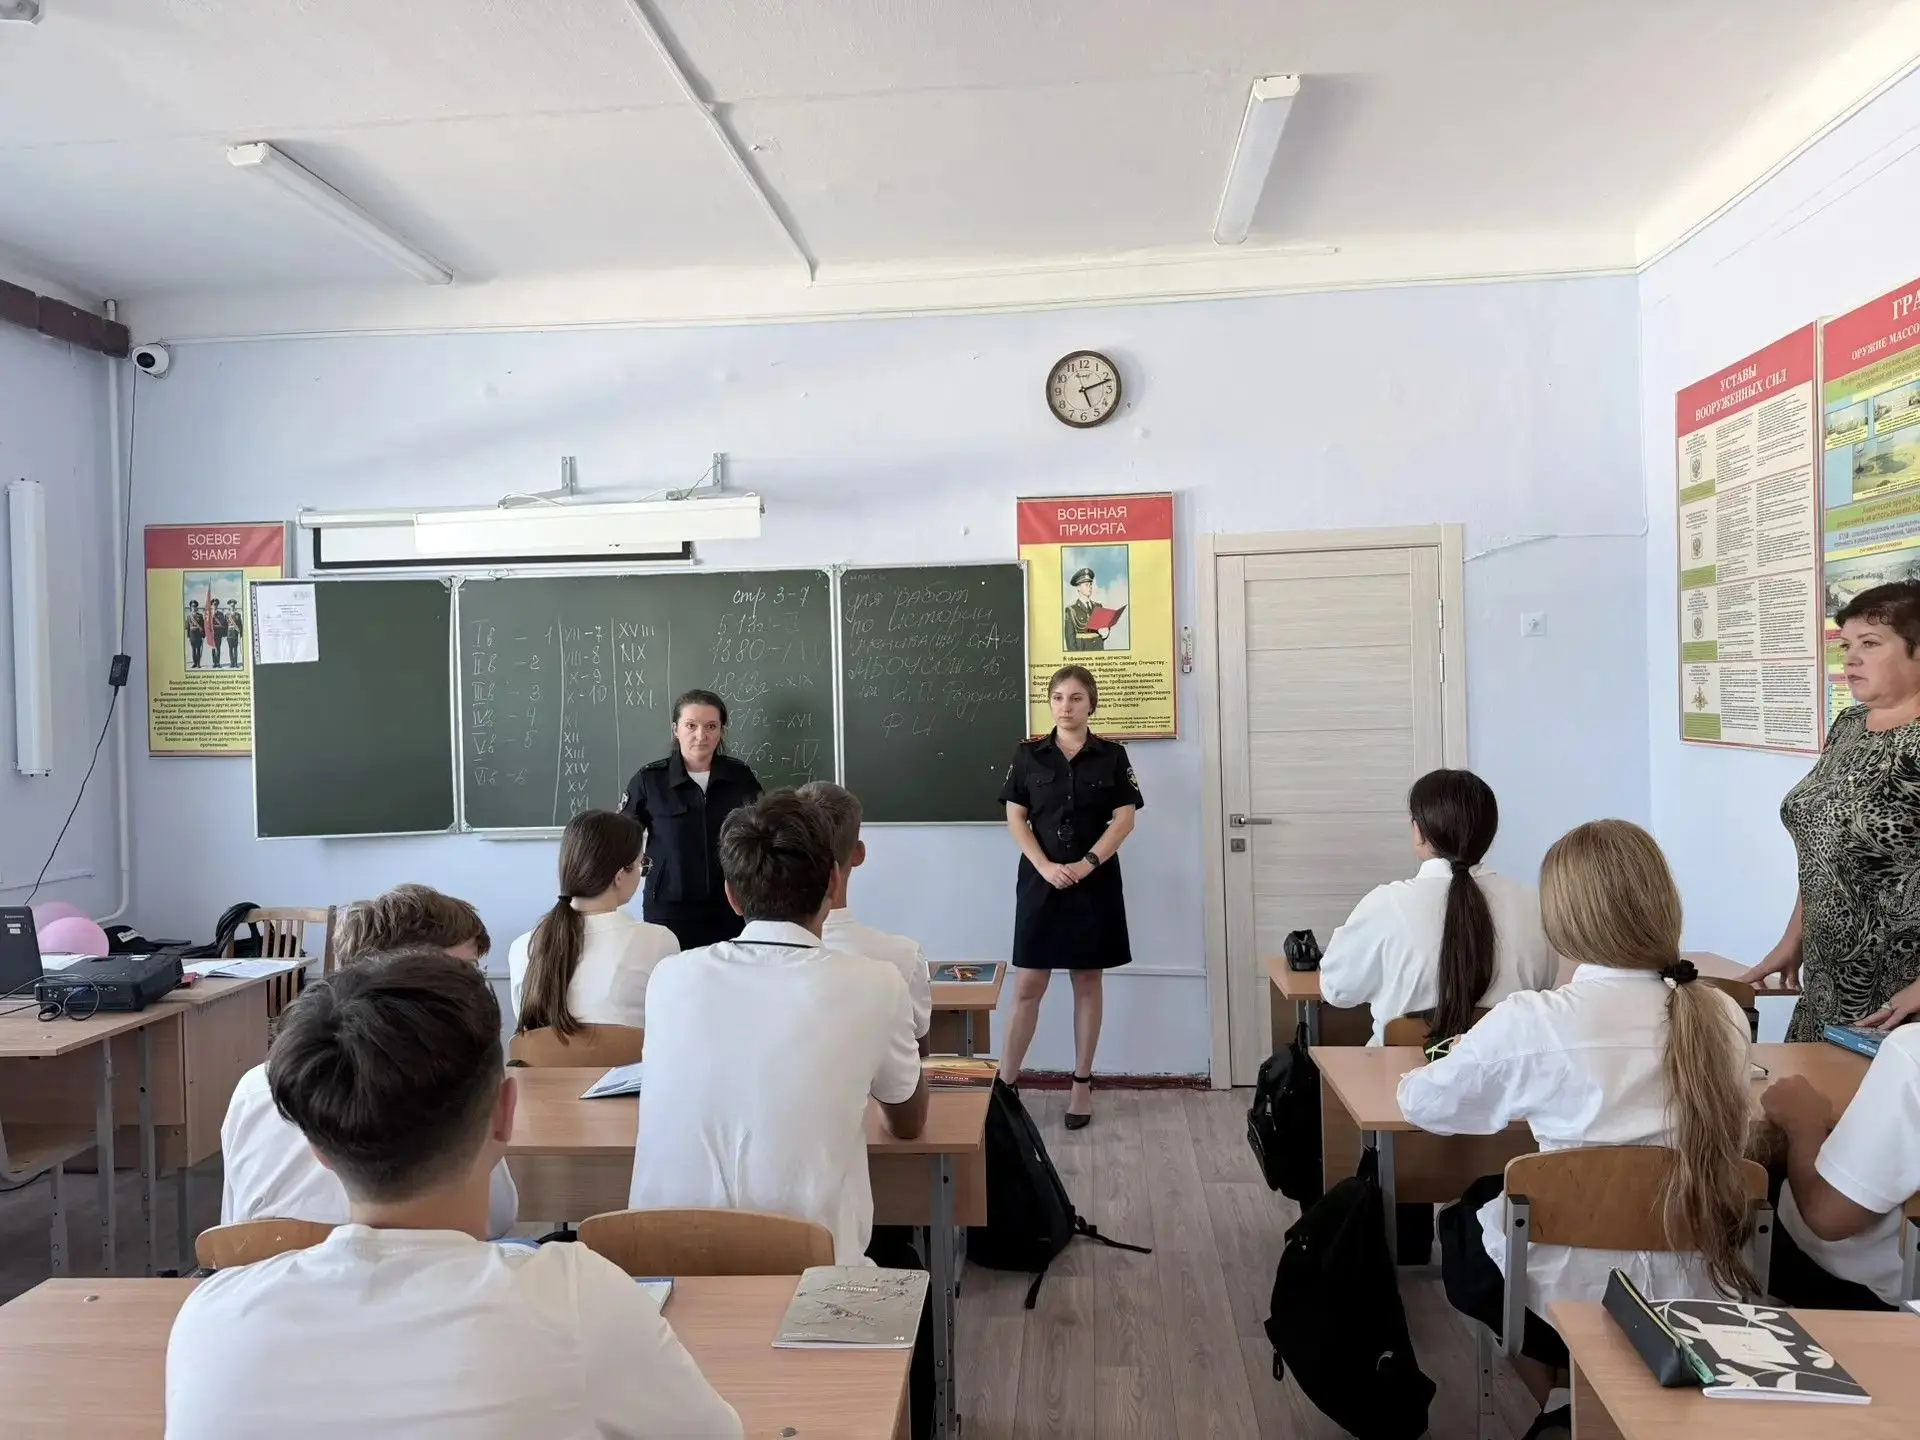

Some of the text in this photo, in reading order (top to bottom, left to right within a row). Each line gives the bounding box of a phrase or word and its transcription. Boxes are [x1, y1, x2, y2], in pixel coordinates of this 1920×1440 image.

[1851, 336, 1887, 361] ОРУЖИЕ
[1067, 363, 1074, 372] 11
[1080, 360, 1090, 369] 12
[1096, 363, 1099, 371] 1
[1057, 374, 1067, 383] 10
[1720, 363, 1757, 392] УСТАВЫ
[1055, 387, 1061, 396] 9
[1106, 385, 1113, 394] 3
[1695, 368, 1787, 421] ВООРУЖЕННЫХ СИЛ
[1059, 400, 1066, 409] 8
[1069, 409, 1074, 418] 7
[1080, 412, 1087, 421] 6
[1093, 408, 1100, 417] 5
[1056, 506, 1128, 521] ВОЕННАЯ
[1059, 522, 1127, 536] ПРИСЯГА
[187, 533, 241, 546] БОЕВОЕ
[191, 547, 237, 561] ЗНАМЯ
[618, 622, 655, 639] XVIII
[624, 670, 646, 686] XX
